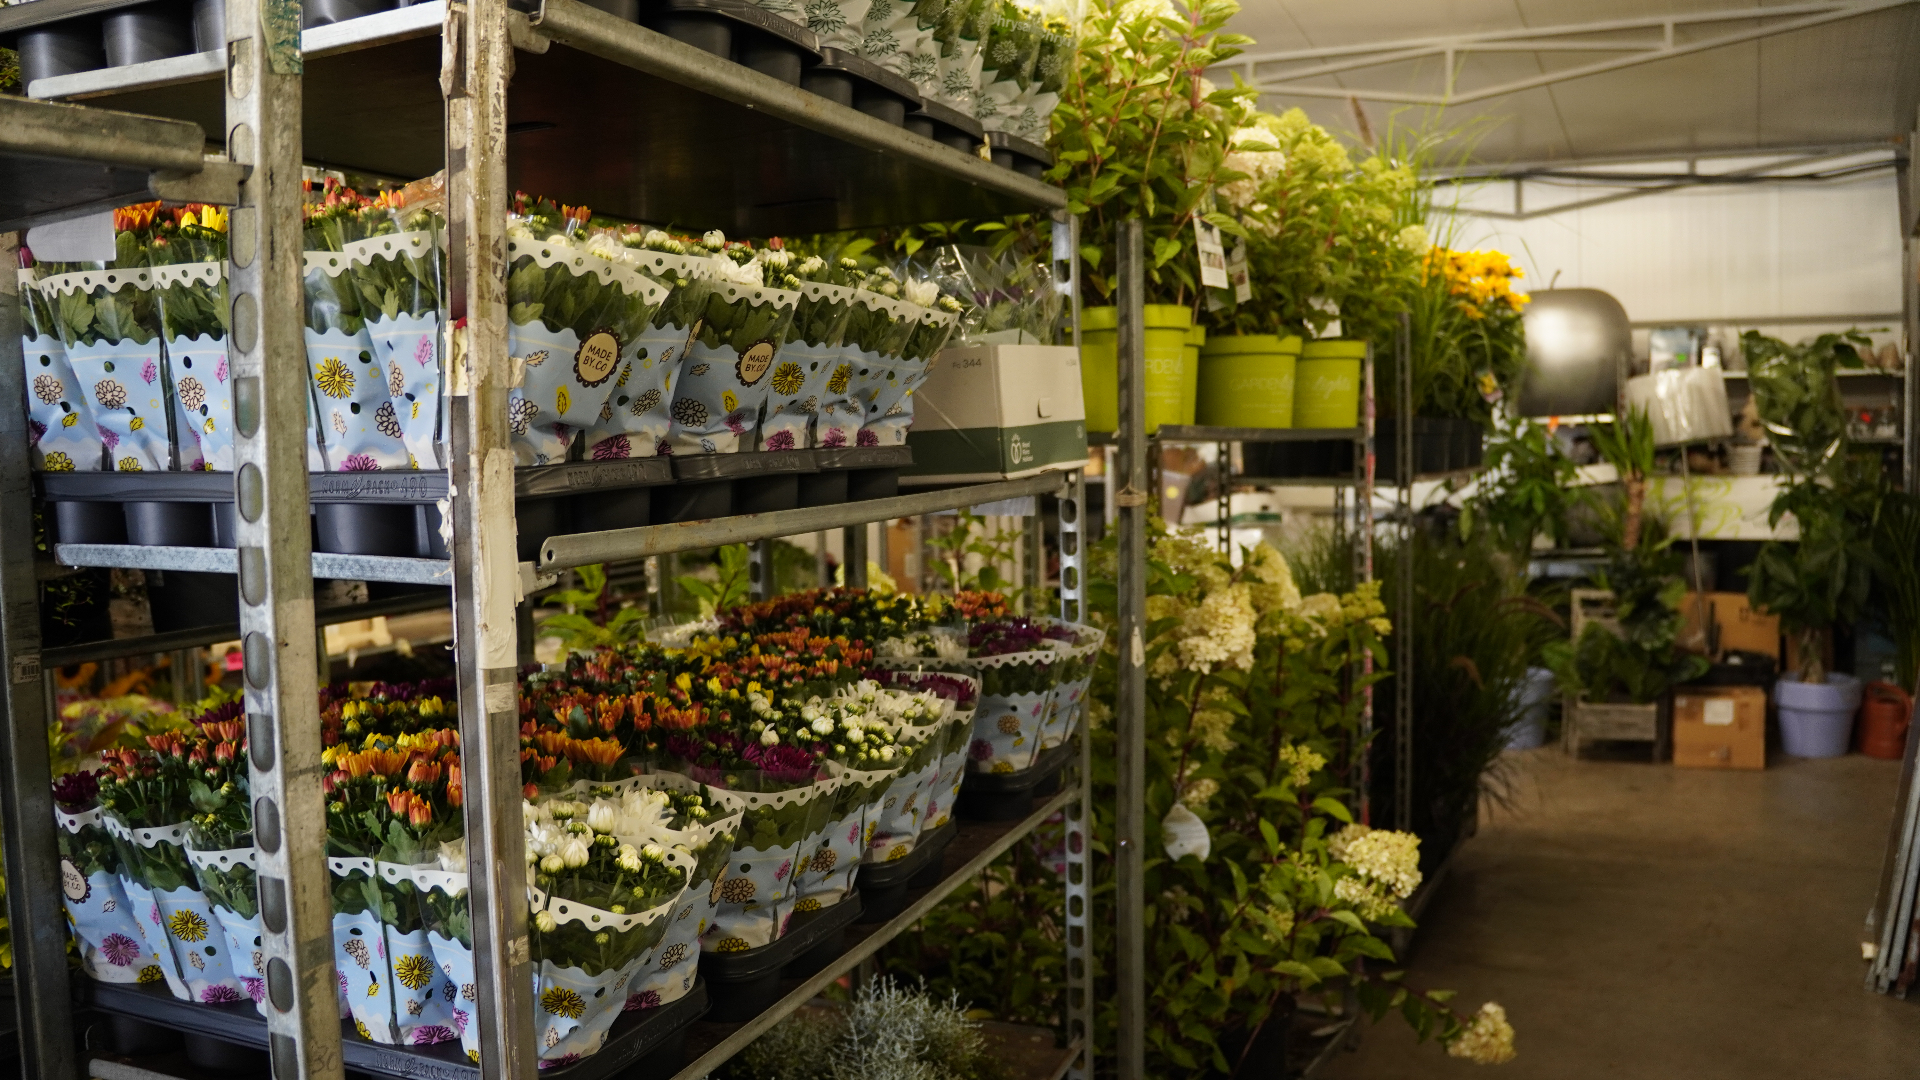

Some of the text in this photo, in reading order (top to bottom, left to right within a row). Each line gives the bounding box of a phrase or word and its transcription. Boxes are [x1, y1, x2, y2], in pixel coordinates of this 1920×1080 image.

[587, 344, 613, 362] MADE
[582, 355, 608, 373] BY.CO
[748, 354, 770, 364] MADE
[962, 358, 982, 369] 344
[745, 363, 766, 373] BY.CO
